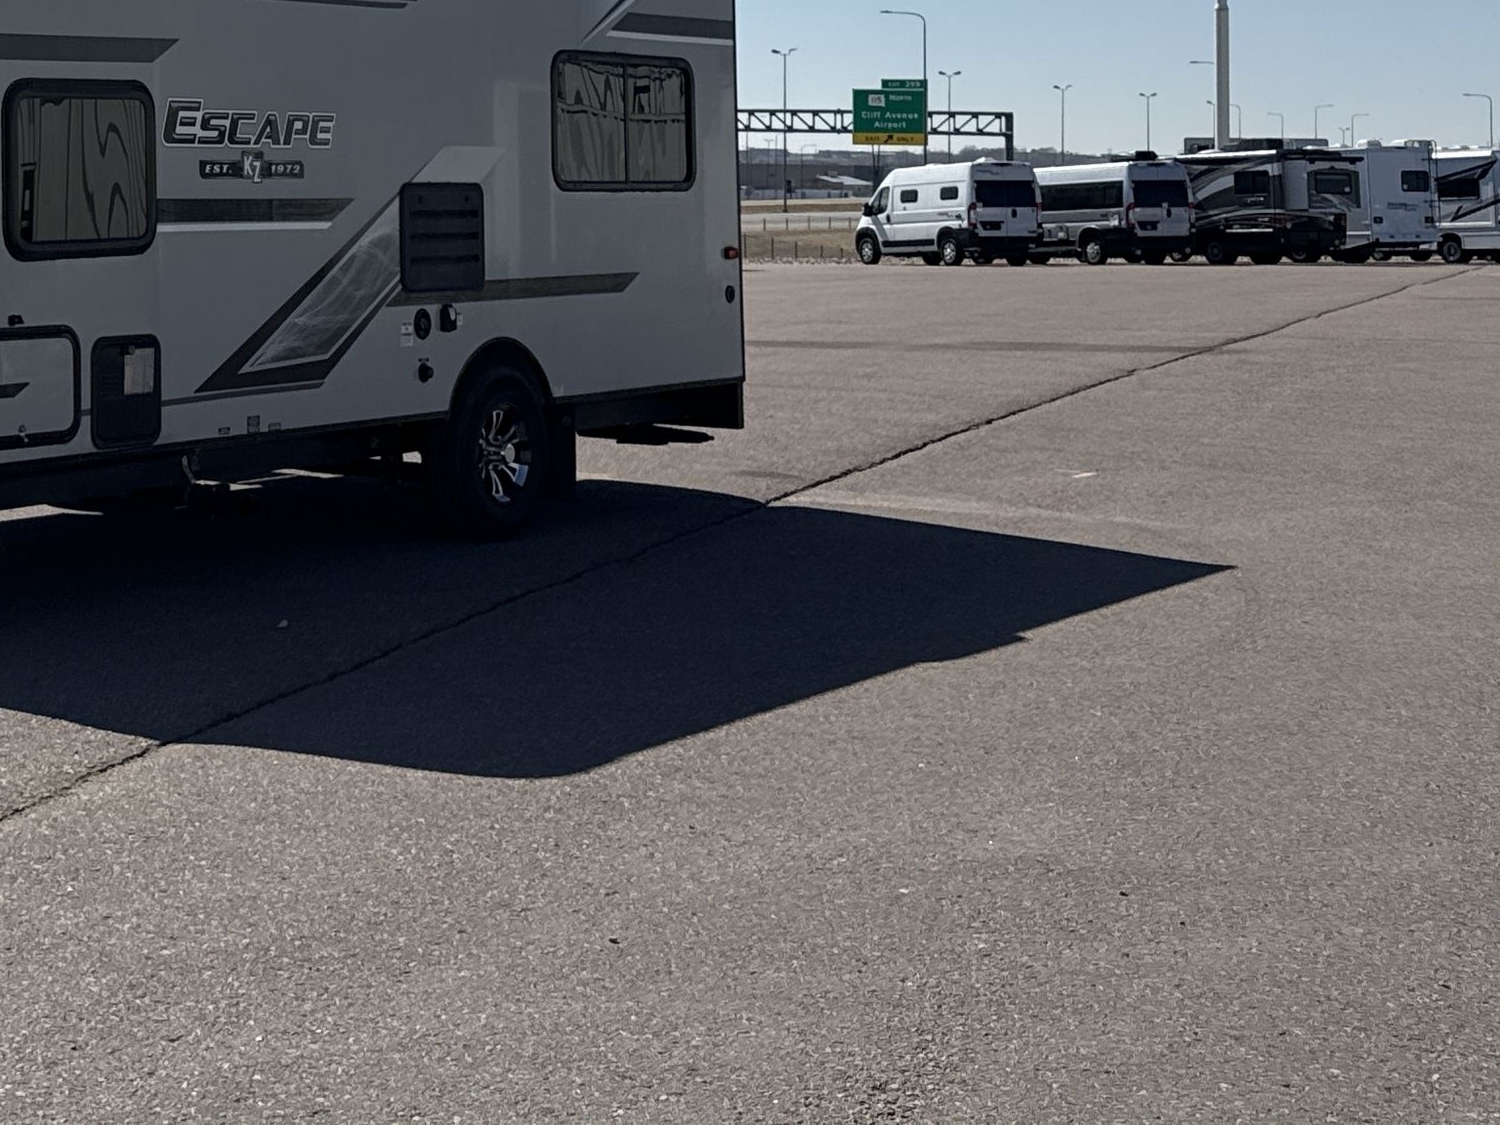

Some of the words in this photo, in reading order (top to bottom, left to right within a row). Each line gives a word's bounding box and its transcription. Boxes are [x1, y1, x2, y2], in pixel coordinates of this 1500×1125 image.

[861, 111, 881, 119] Cliff
[885, 111, 918, 119] Avenue
[162, 98, 336, 149] ESCAPE
[874, 121, 906, 129] Airport
[205, 163, 232, 174] EST.
[271, 163, 300, 174] 1972
